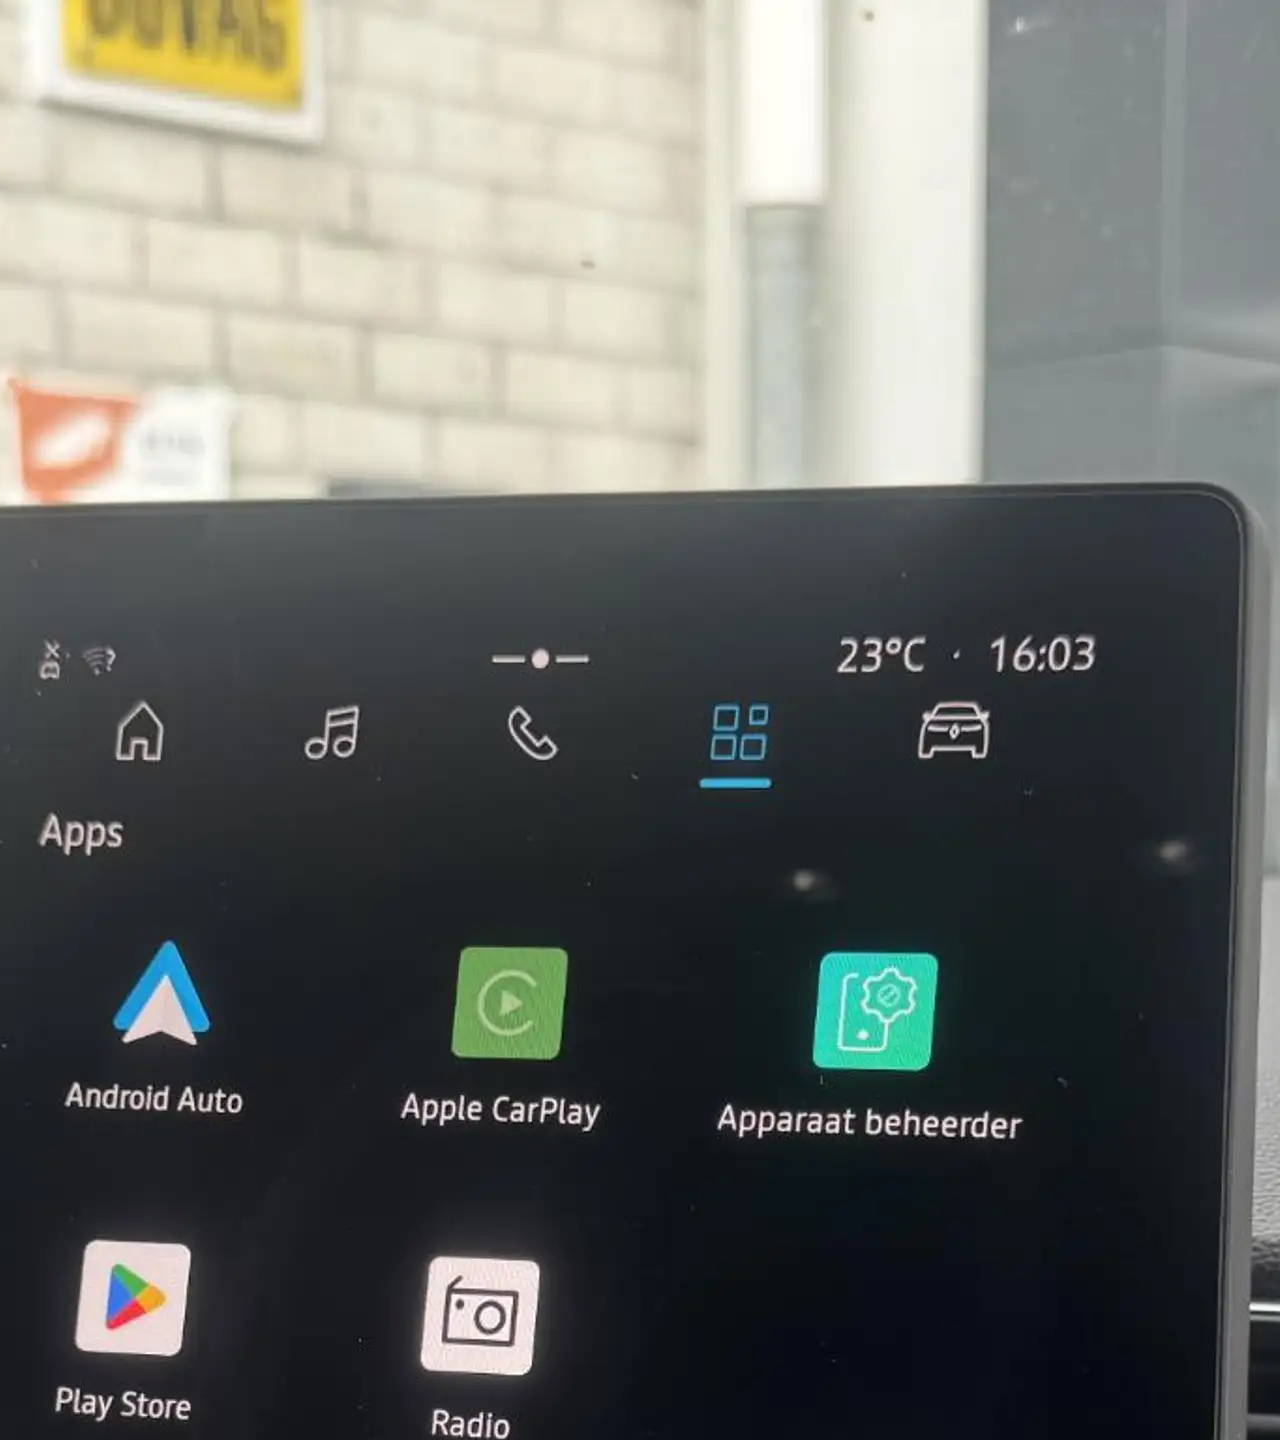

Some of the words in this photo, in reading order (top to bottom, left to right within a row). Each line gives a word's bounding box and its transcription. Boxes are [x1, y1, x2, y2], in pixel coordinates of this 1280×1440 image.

[837, 637, 927, 673] 23°C
[991, 636, 1096, 673] 16:03
[39, 813, 124, 856] Apps
[65, 1082, 169, 1113] Android
[177, 1085, 244, 1114] Auto
[400, 1092, 483, 1126] Apple
[492, 1096, 601, 1132] CarPlay
[717, 1104, 856, 1139] Apparaat
[865, 1108, 1024, 1139] beheerder
[55, 1386, 113, 1423] Play
[121, 1389, 193, 1422] Store
[431, 1408, 511, 1440] Radio
